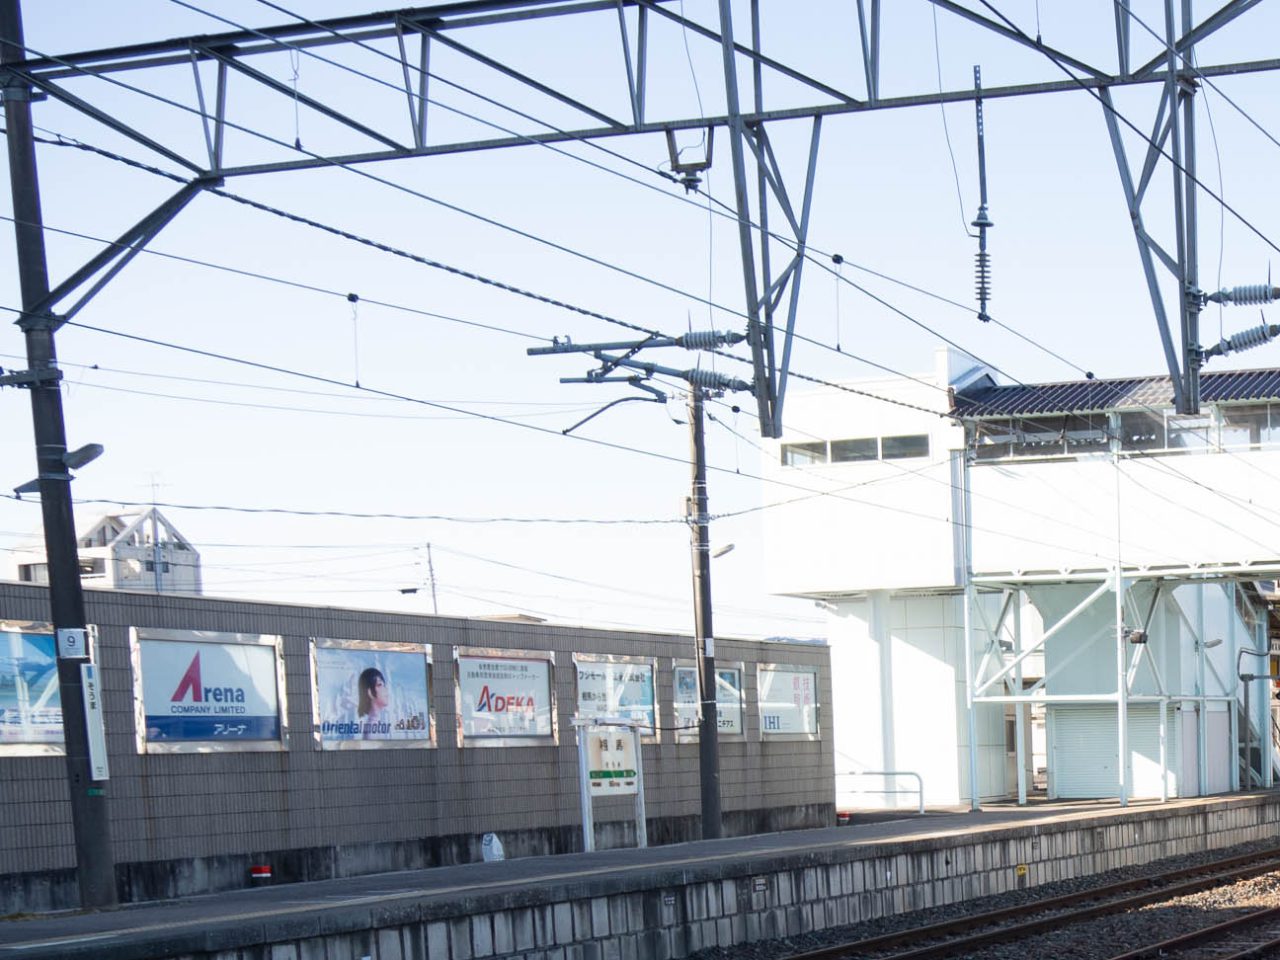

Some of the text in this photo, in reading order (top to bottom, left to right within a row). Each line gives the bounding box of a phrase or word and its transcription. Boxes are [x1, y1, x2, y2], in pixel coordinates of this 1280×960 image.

[170, 649, 245, 703] Arena
[476, 685, 536, 713] ADEKA
[170, 705, 246, 714] COMPANY LIMITED
[213, 723, 247, 735] アリーナ
[764, 715, 780, 730] IHI
